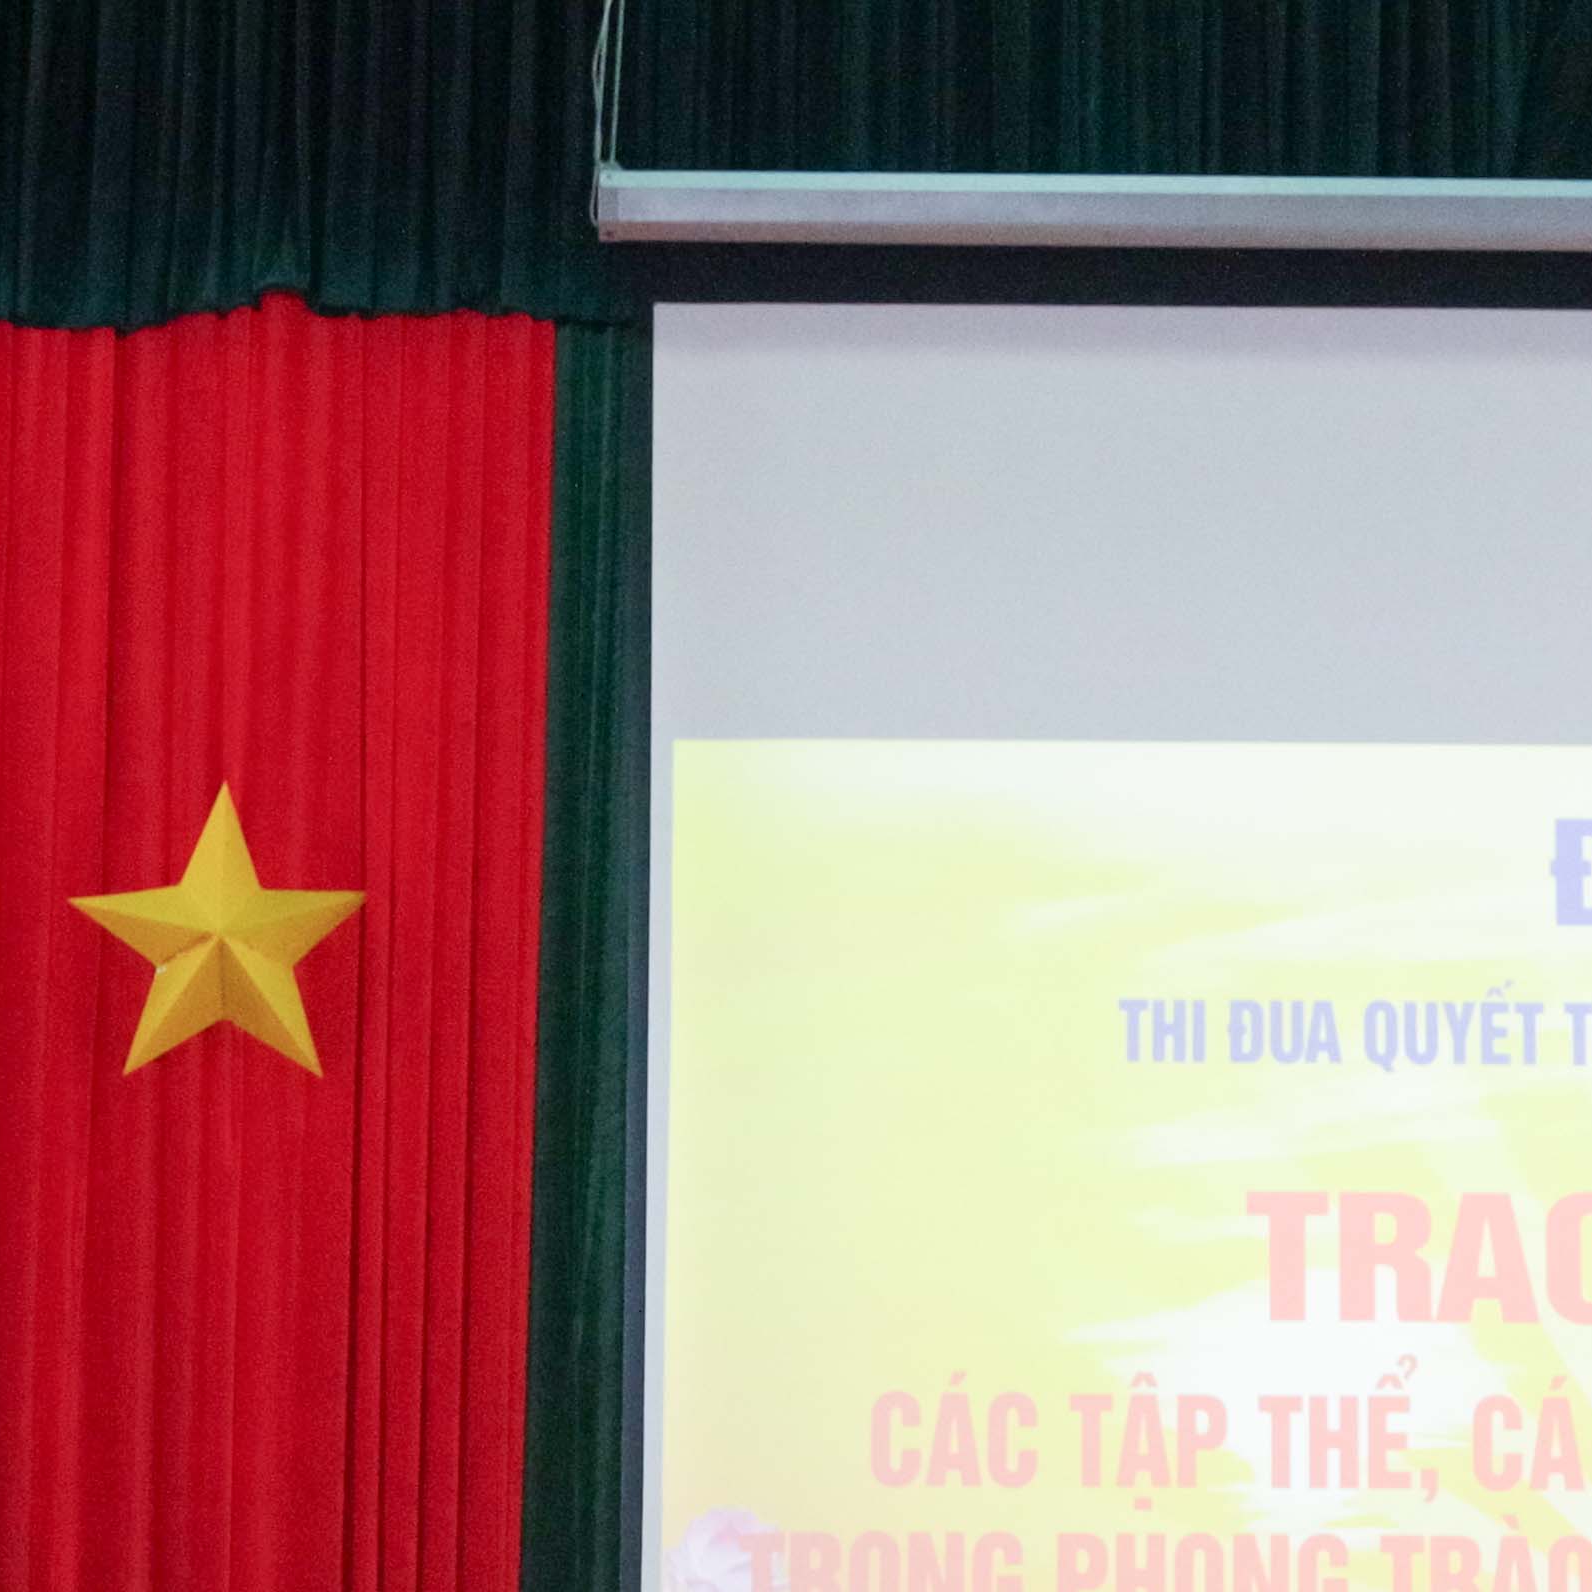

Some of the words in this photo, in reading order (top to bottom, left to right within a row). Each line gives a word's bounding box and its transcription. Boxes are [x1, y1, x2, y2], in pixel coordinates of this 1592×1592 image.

[1118, 999, 1206, 1064] THI
[1227, 1000, 1343, 1065] ĐUA
[1363, 980, 1544, 1073] QUYẾT
[870, 1371, 1038, 1487] CÁC
[1069, 1371, 1228, 1511] TẬP
[1258, 1354, 1439, 1503] THỂ,
[1472, 1375, 1585, 1493] CÁ
